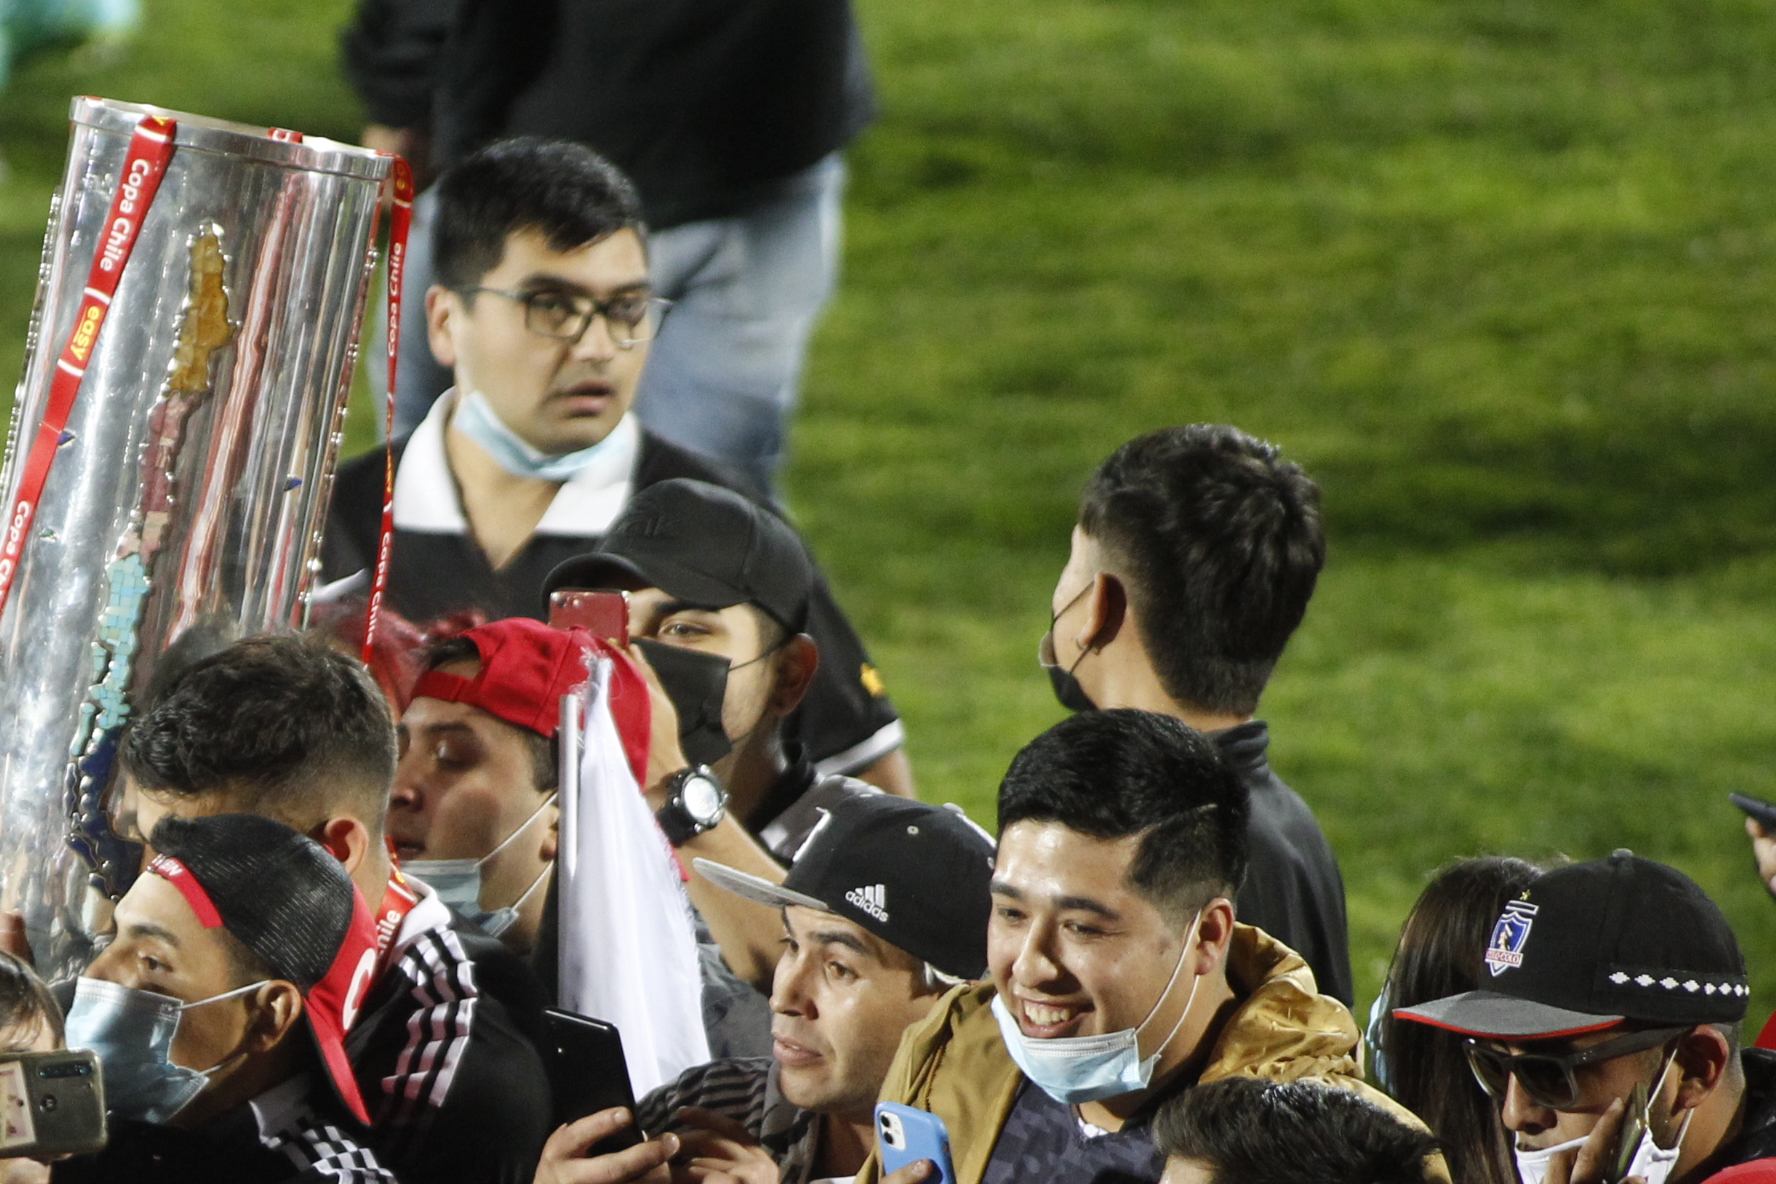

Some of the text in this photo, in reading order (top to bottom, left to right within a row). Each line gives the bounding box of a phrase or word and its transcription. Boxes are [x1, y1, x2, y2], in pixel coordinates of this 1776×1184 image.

[99, 158, 150, 273] Copa Chile
[70, 305, 101, 361] easy
[5, 500, 30, 556] Copa
[845, 890, 889, 922] adidas
